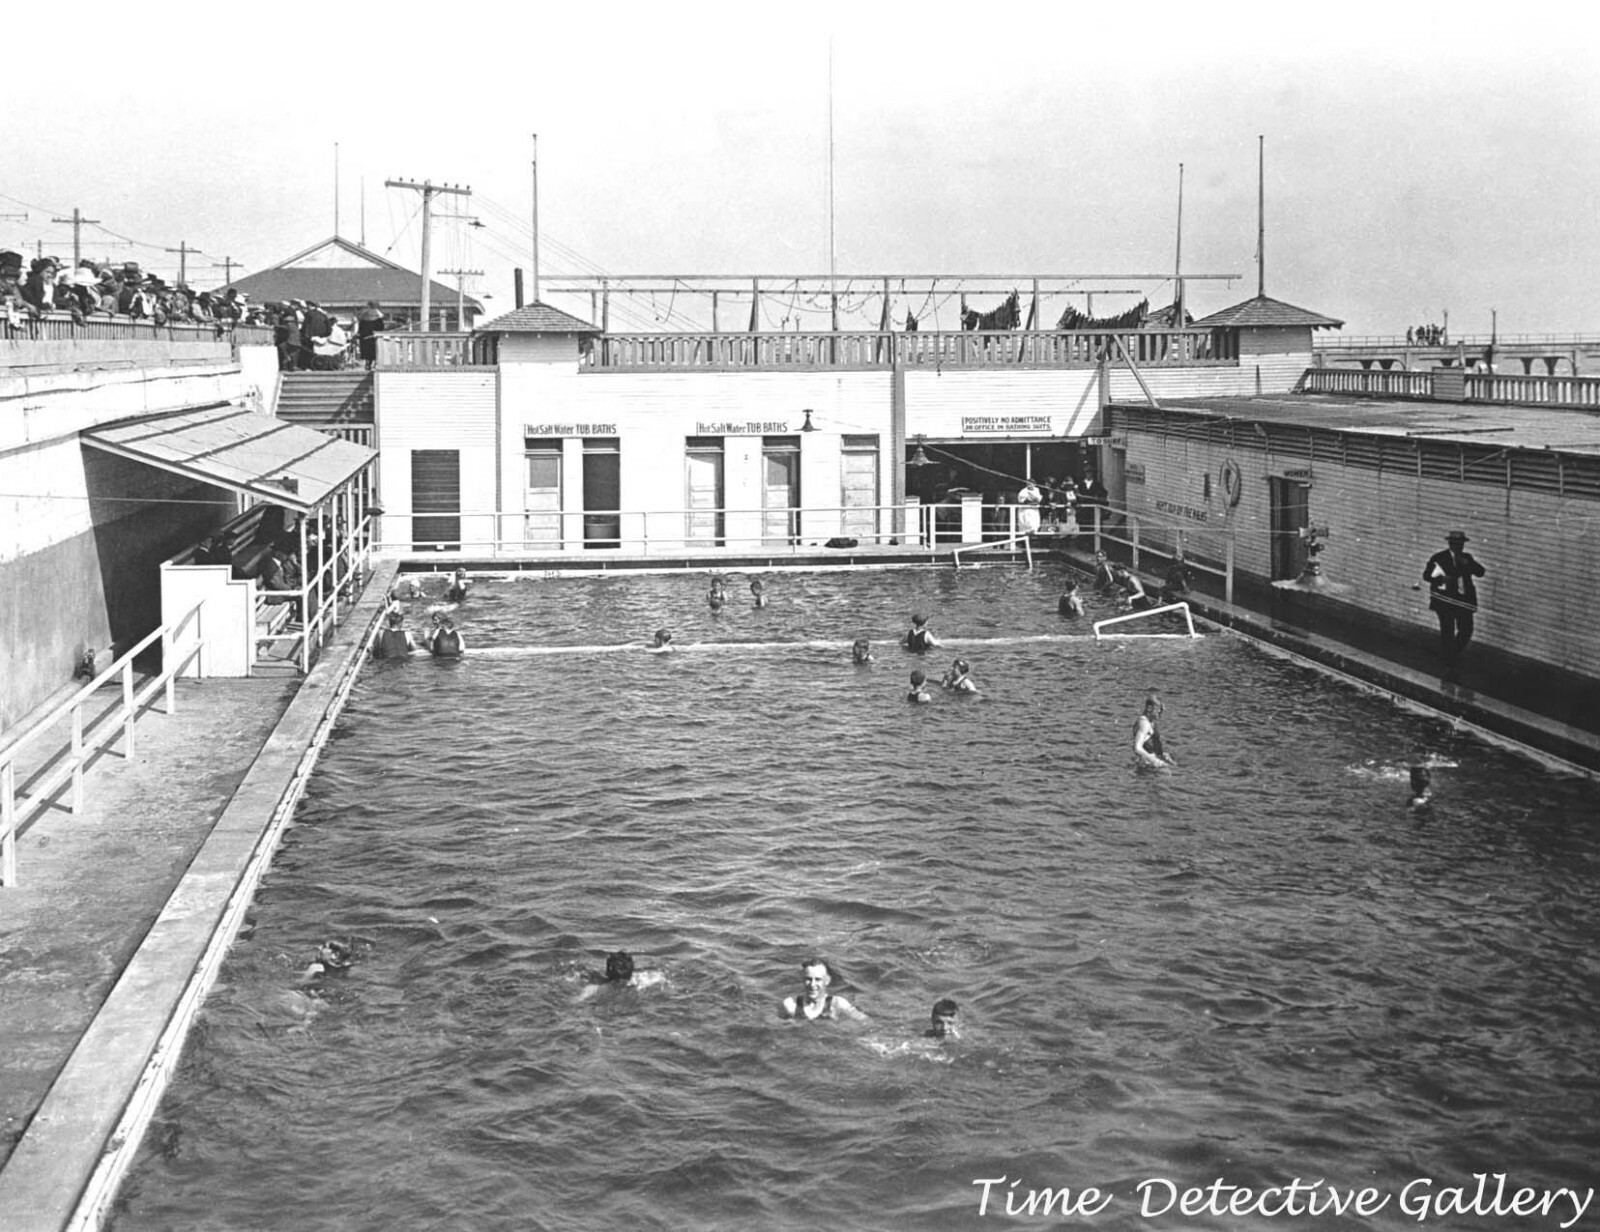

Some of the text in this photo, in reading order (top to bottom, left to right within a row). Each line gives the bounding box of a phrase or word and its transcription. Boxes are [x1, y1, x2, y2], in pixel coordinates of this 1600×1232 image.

[964, 415, 1052, 424] POSITIVELY NO ADMITTANCE
[527, 424, 617, 435] Hot Salt Water TUB BATHS
[699, 422, 788, 434] Hot Salt Water TUB BATHS
